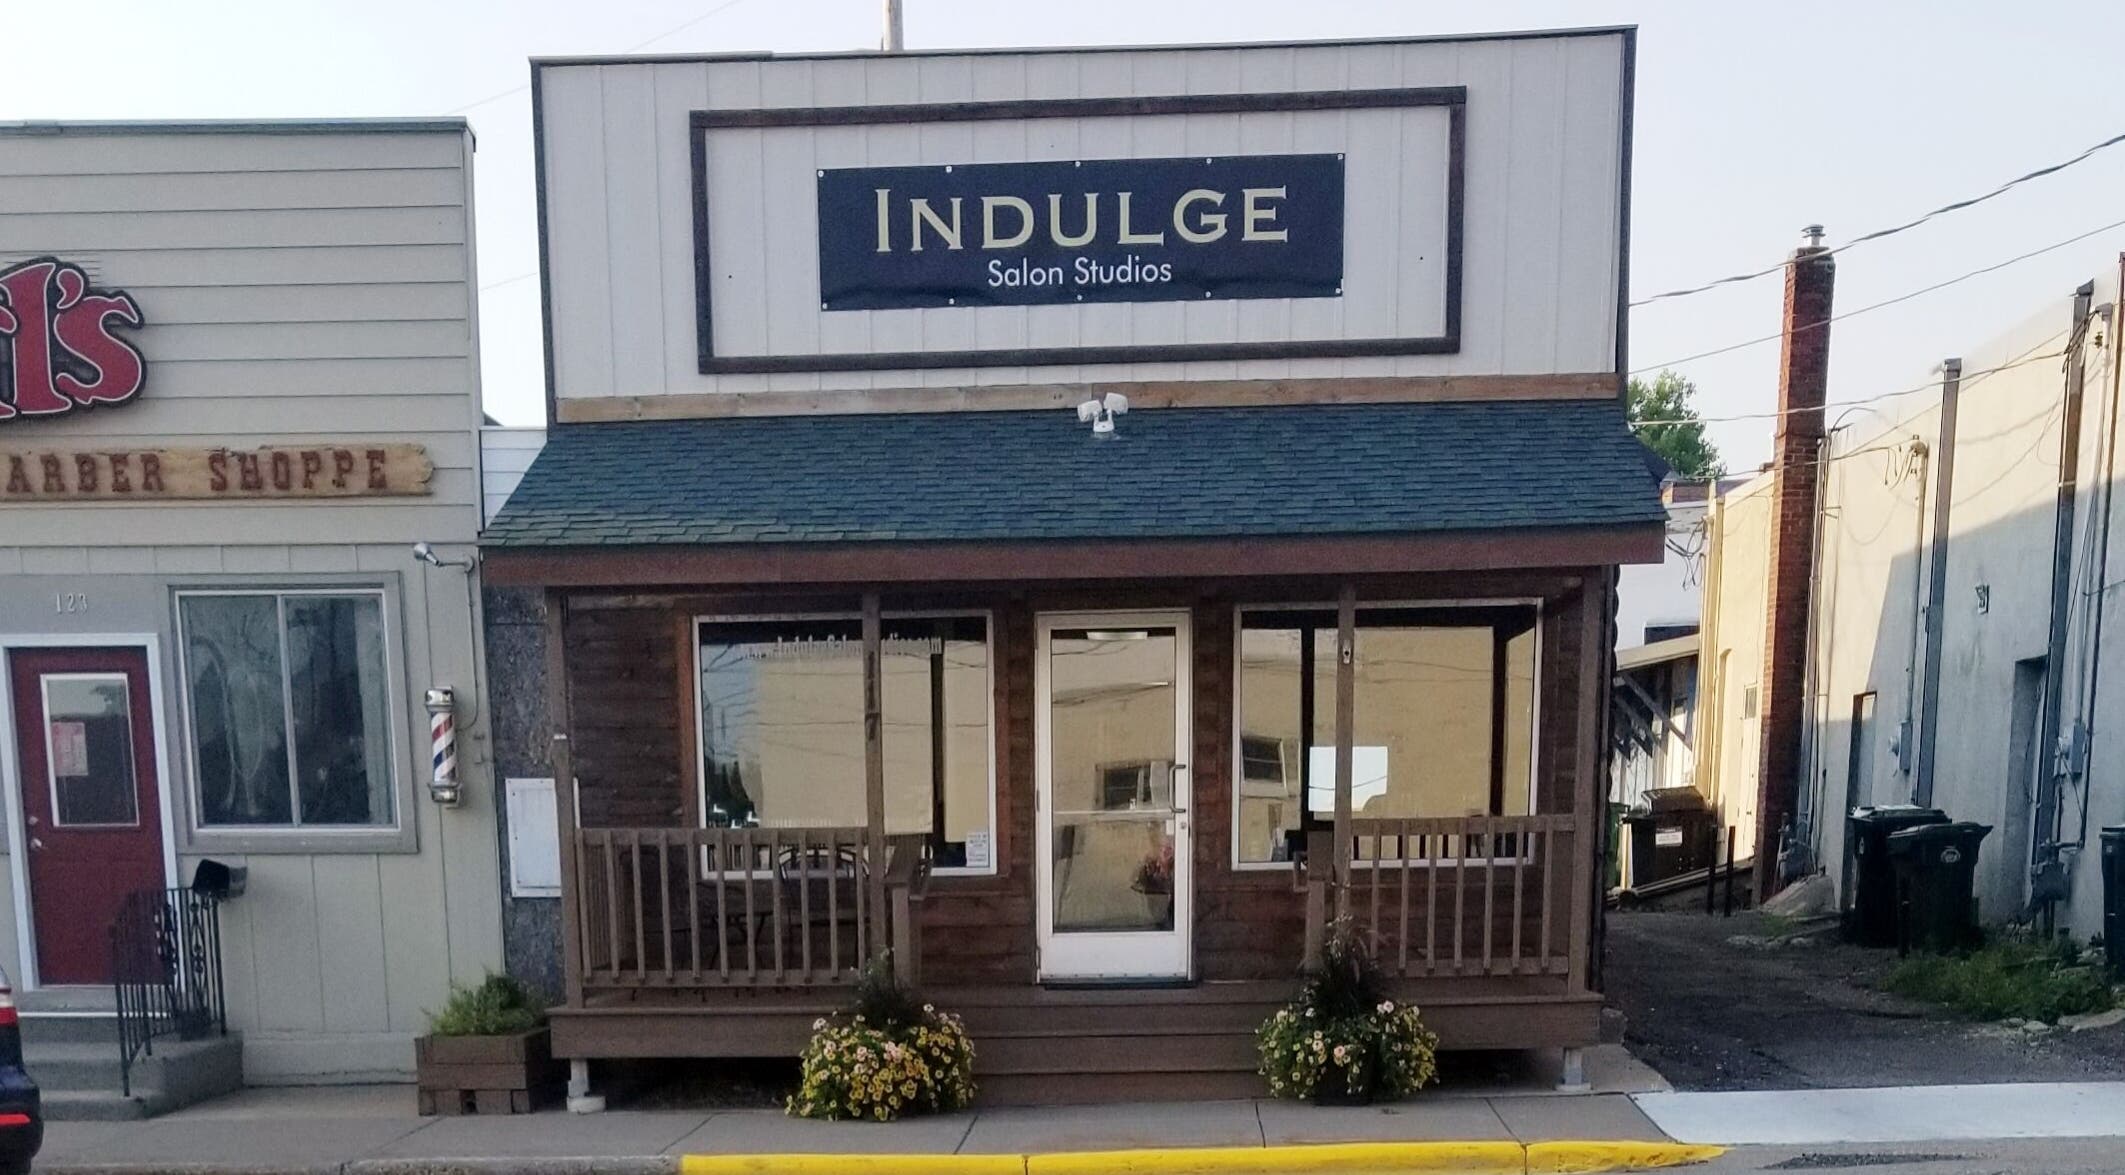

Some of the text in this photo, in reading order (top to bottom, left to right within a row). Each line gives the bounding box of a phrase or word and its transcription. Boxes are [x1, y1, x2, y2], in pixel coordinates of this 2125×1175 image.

[875, 185, 1288, 252] INDULGE
[988, 254, 1172, 287] Salon Studios
[208, 449, 387, 491] SHOPPE
[56, 592, 88, 612] 123
